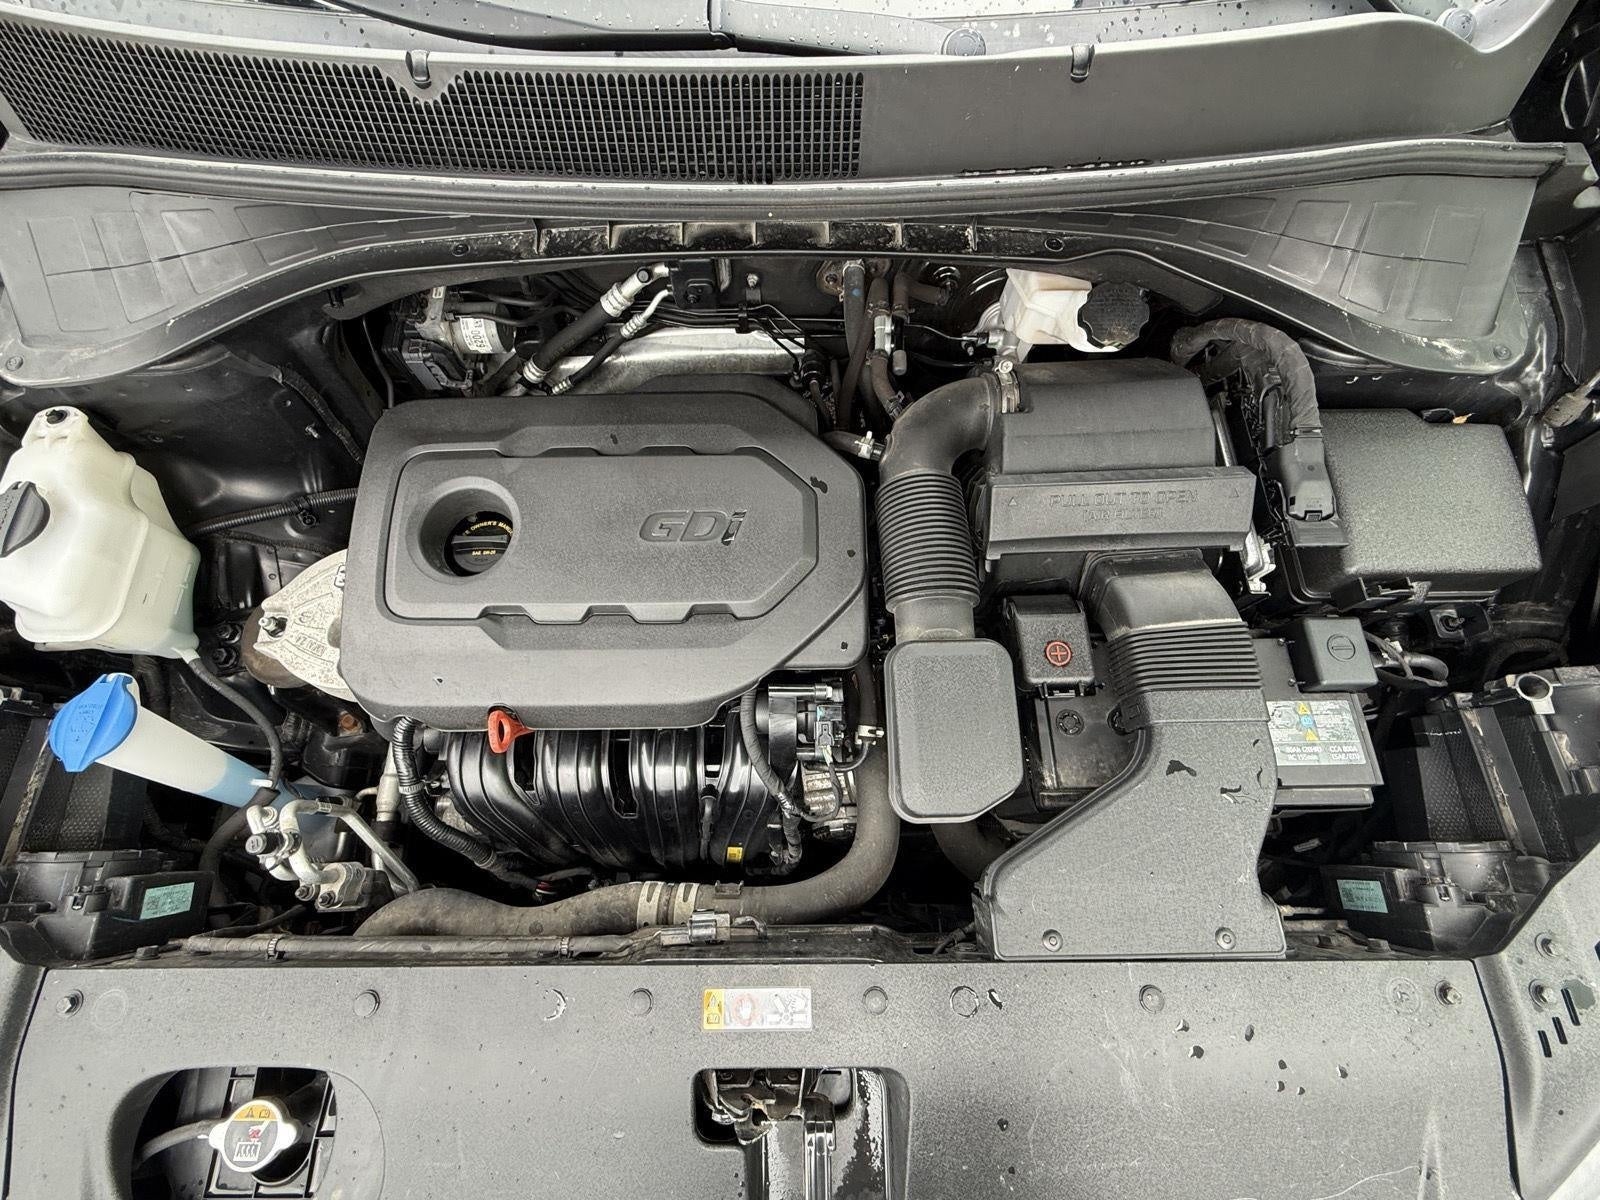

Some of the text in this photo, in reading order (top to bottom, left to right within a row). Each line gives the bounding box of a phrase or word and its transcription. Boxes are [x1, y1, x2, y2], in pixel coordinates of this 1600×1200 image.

[1049, 493, 1090, 508] PULL
[1094, 491, 1127, 507] OUT
[1155, 489, 1199, 505] OPEN
[470, 520, 497, 531] OWNER'S
[1329, 745, 1342, 753] CCA
